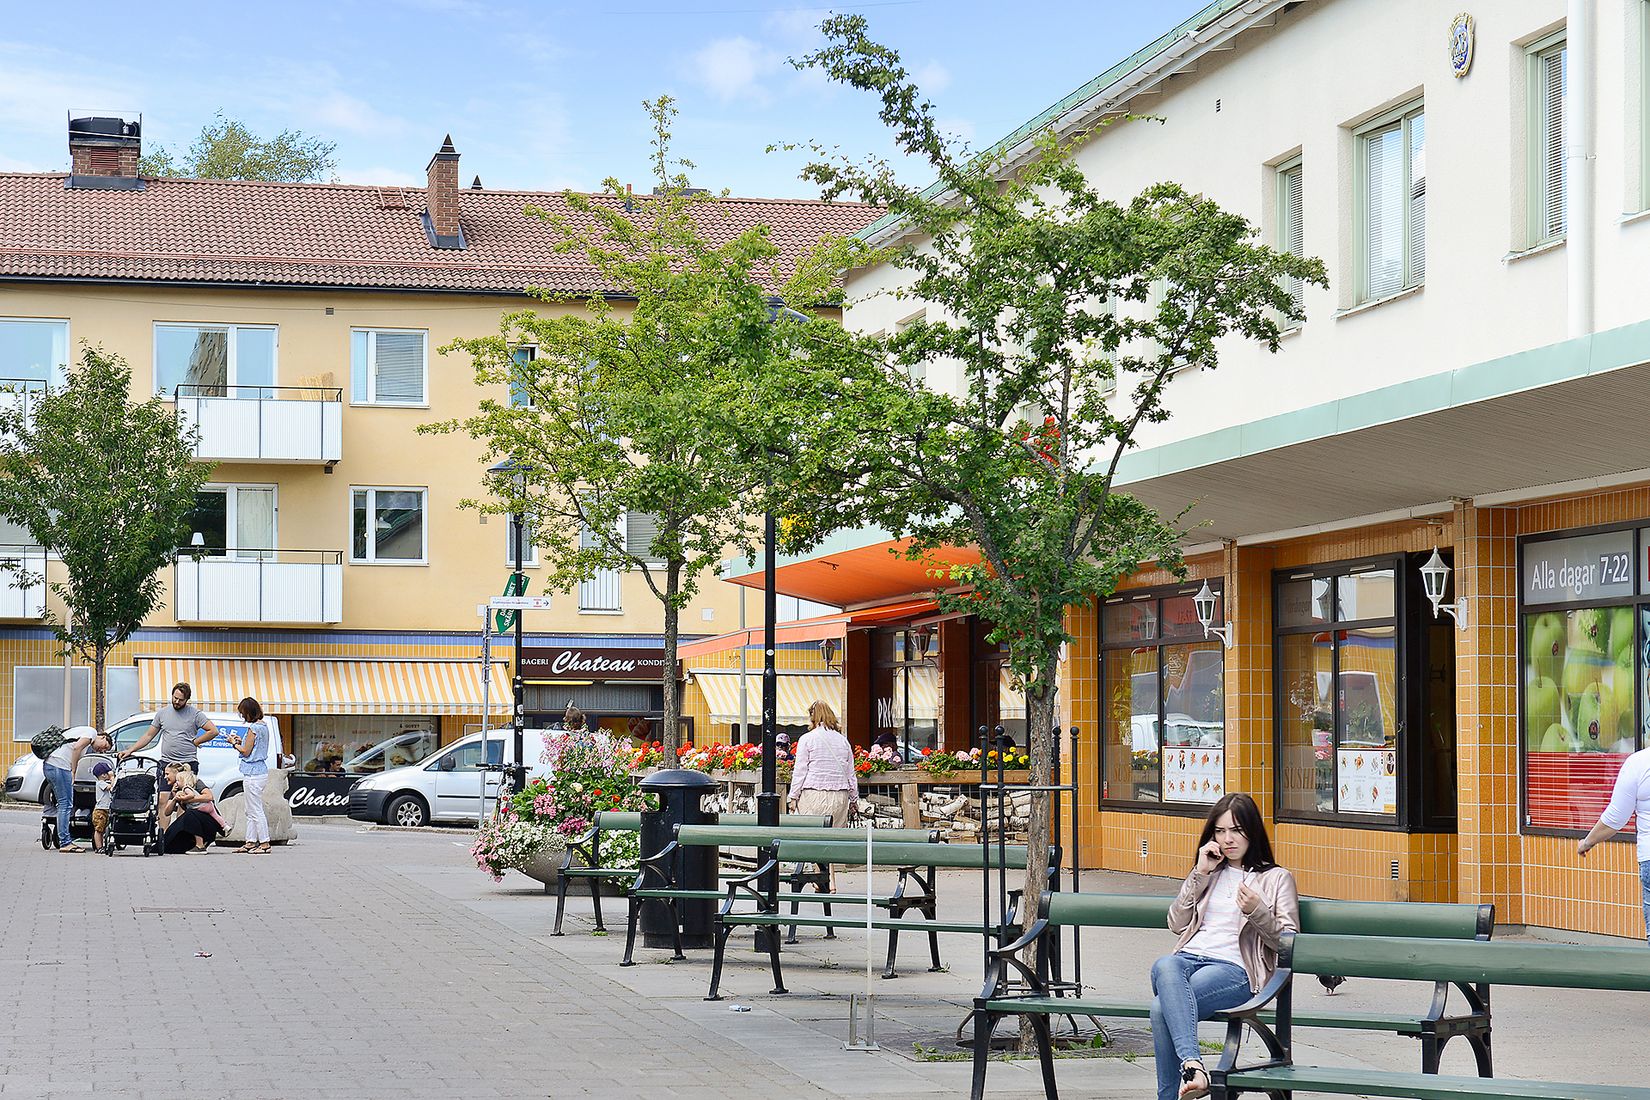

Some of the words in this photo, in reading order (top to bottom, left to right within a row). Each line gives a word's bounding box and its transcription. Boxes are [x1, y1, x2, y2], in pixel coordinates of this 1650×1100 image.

[1531, 560, 1555, 591] Alla
[1559, 558, 1596, 595] dagar
[1600, 554, 1629, 583] 7-22
[521, 658, 549, 666] BAGERI
[551, 650, 636, 675] Chateau
[288, 786, 350, 809] Chatea
